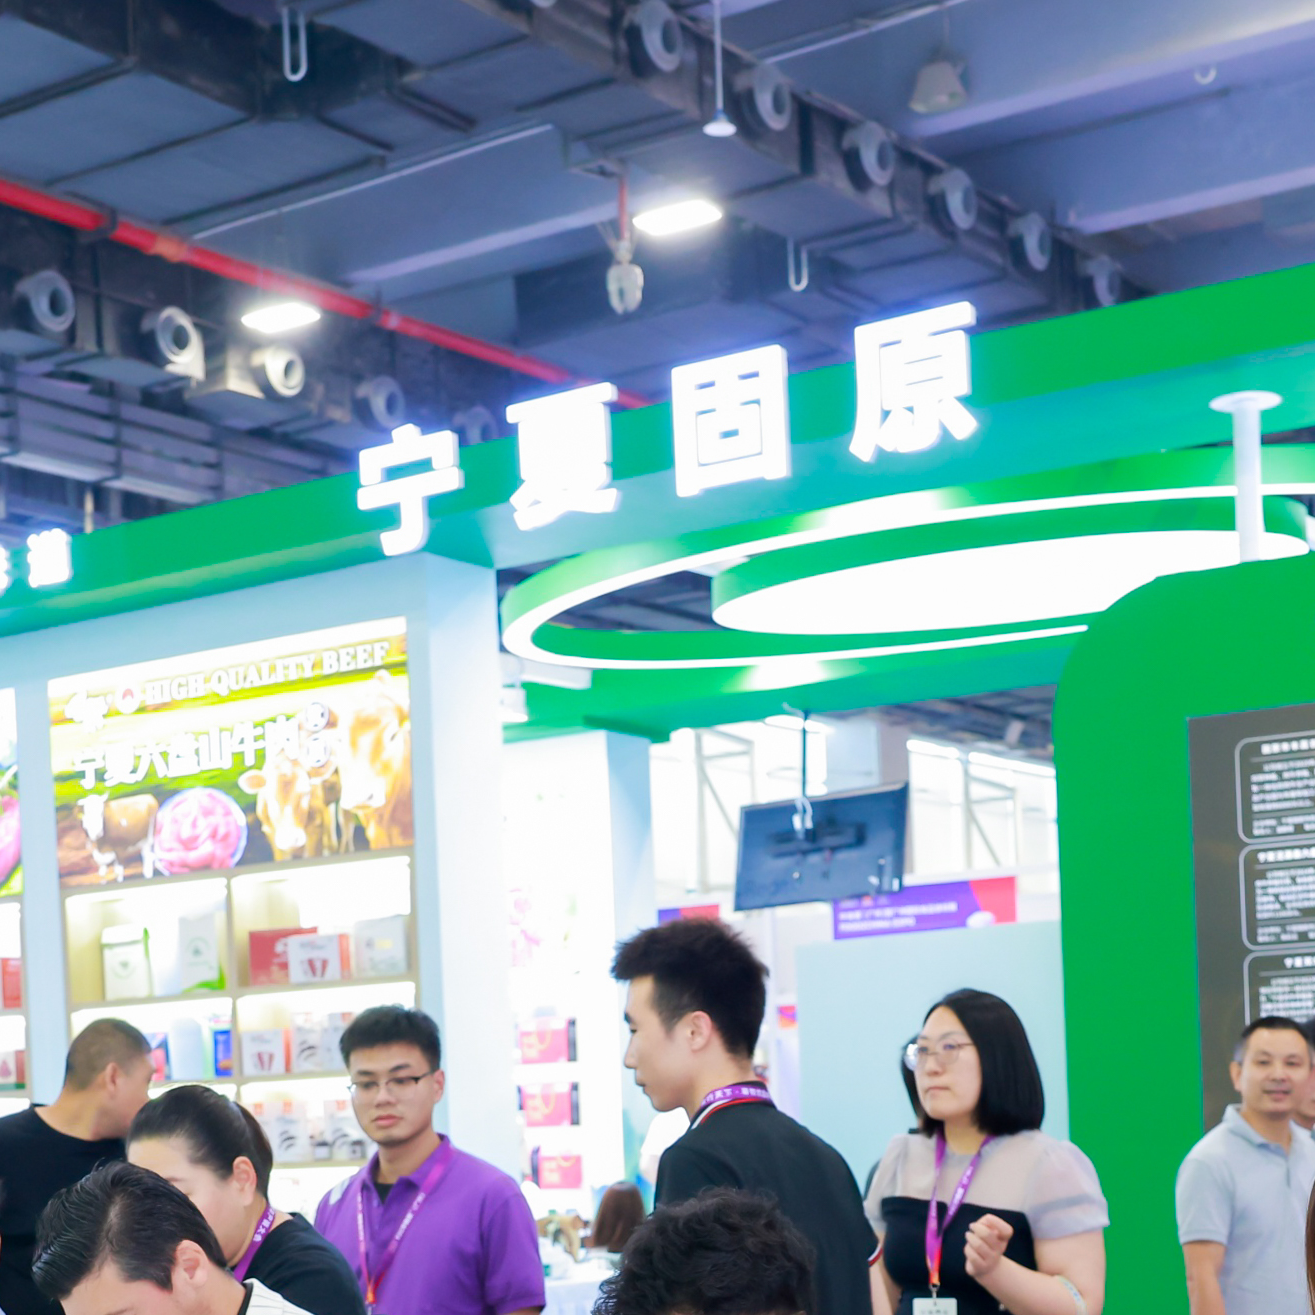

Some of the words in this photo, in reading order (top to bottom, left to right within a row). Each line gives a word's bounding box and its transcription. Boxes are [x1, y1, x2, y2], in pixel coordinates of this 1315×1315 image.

[356, 300, 980, 557] 宁夏固原
[322, 641, 390, 676] BEEF
